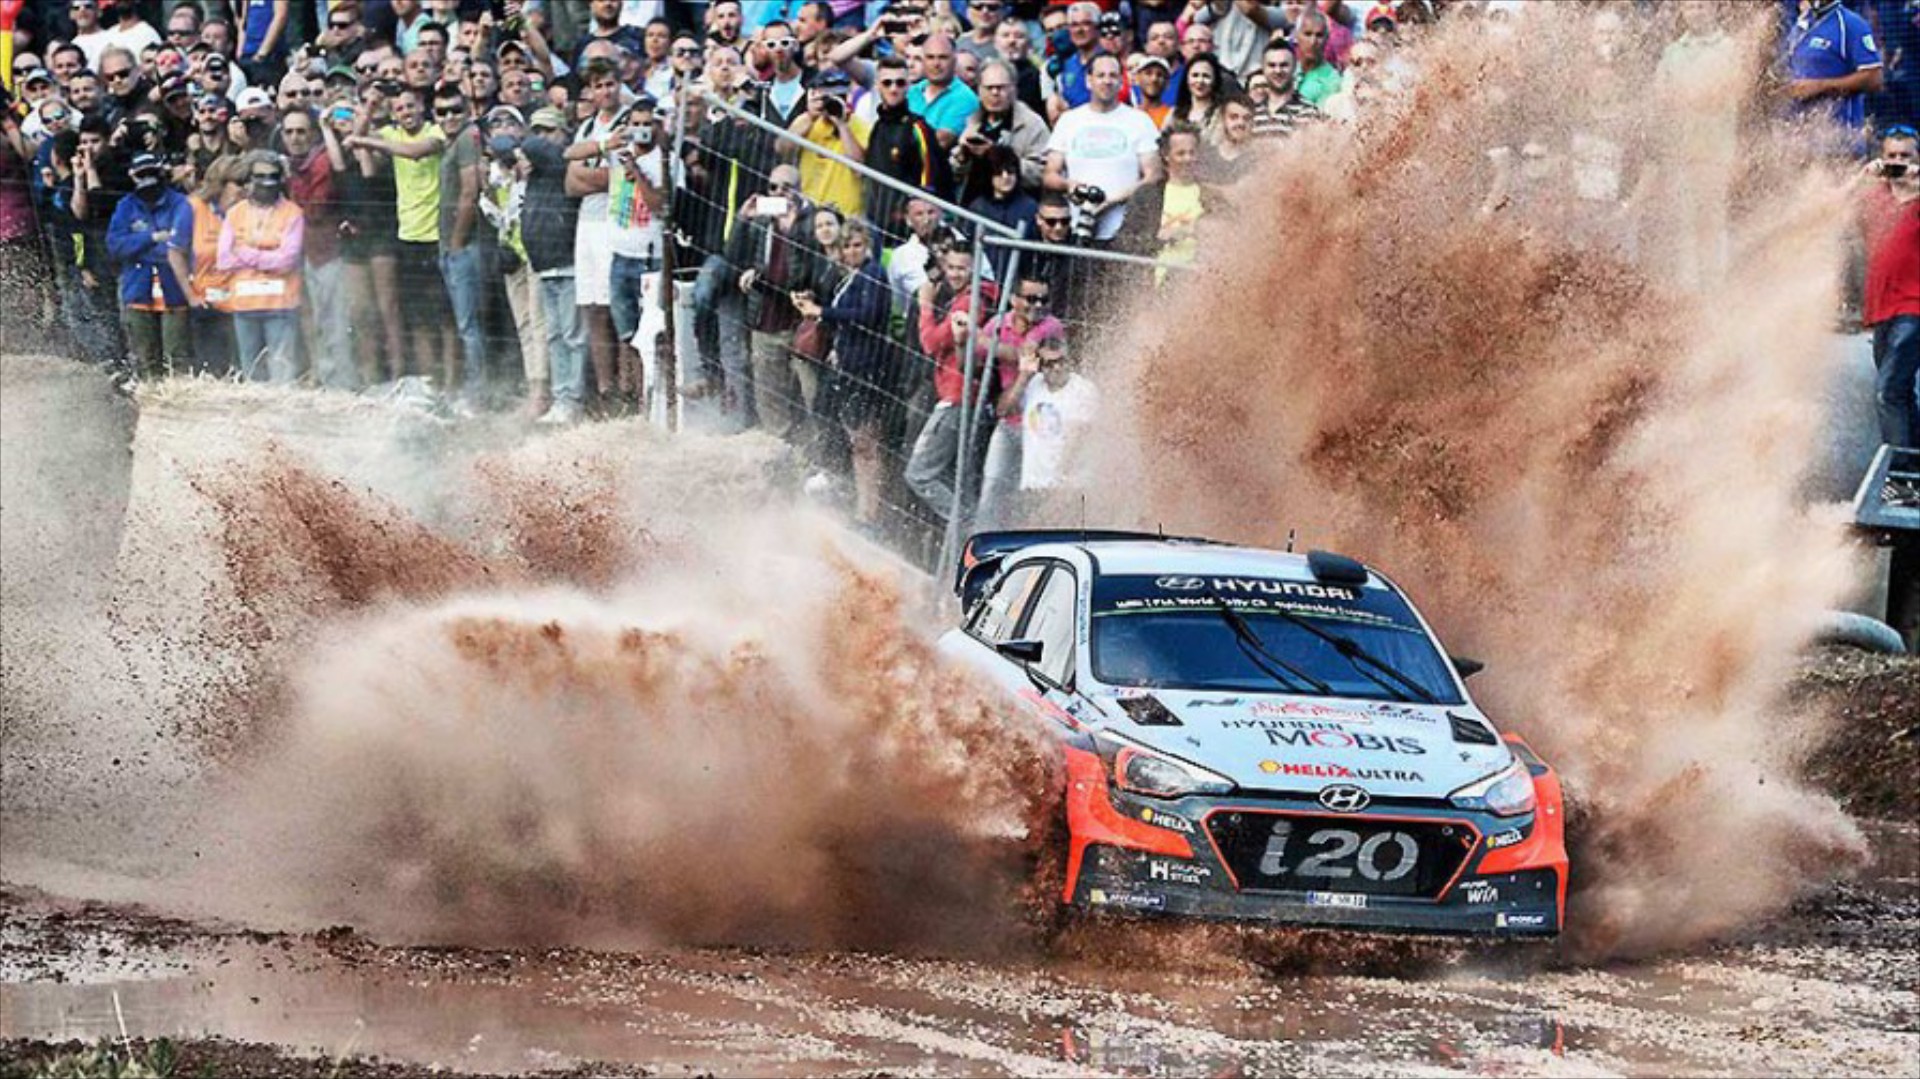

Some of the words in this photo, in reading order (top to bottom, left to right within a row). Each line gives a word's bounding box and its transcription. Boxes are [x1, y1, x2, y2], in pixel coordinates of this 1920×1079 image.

[1212, 578, 1354, 600] HYUNDAI
[1264, 730, 1427, 756] MOBIS
[1283, 763, 1351, 779] HELIX
[1356, 767, 1425, 783] ULTRA
